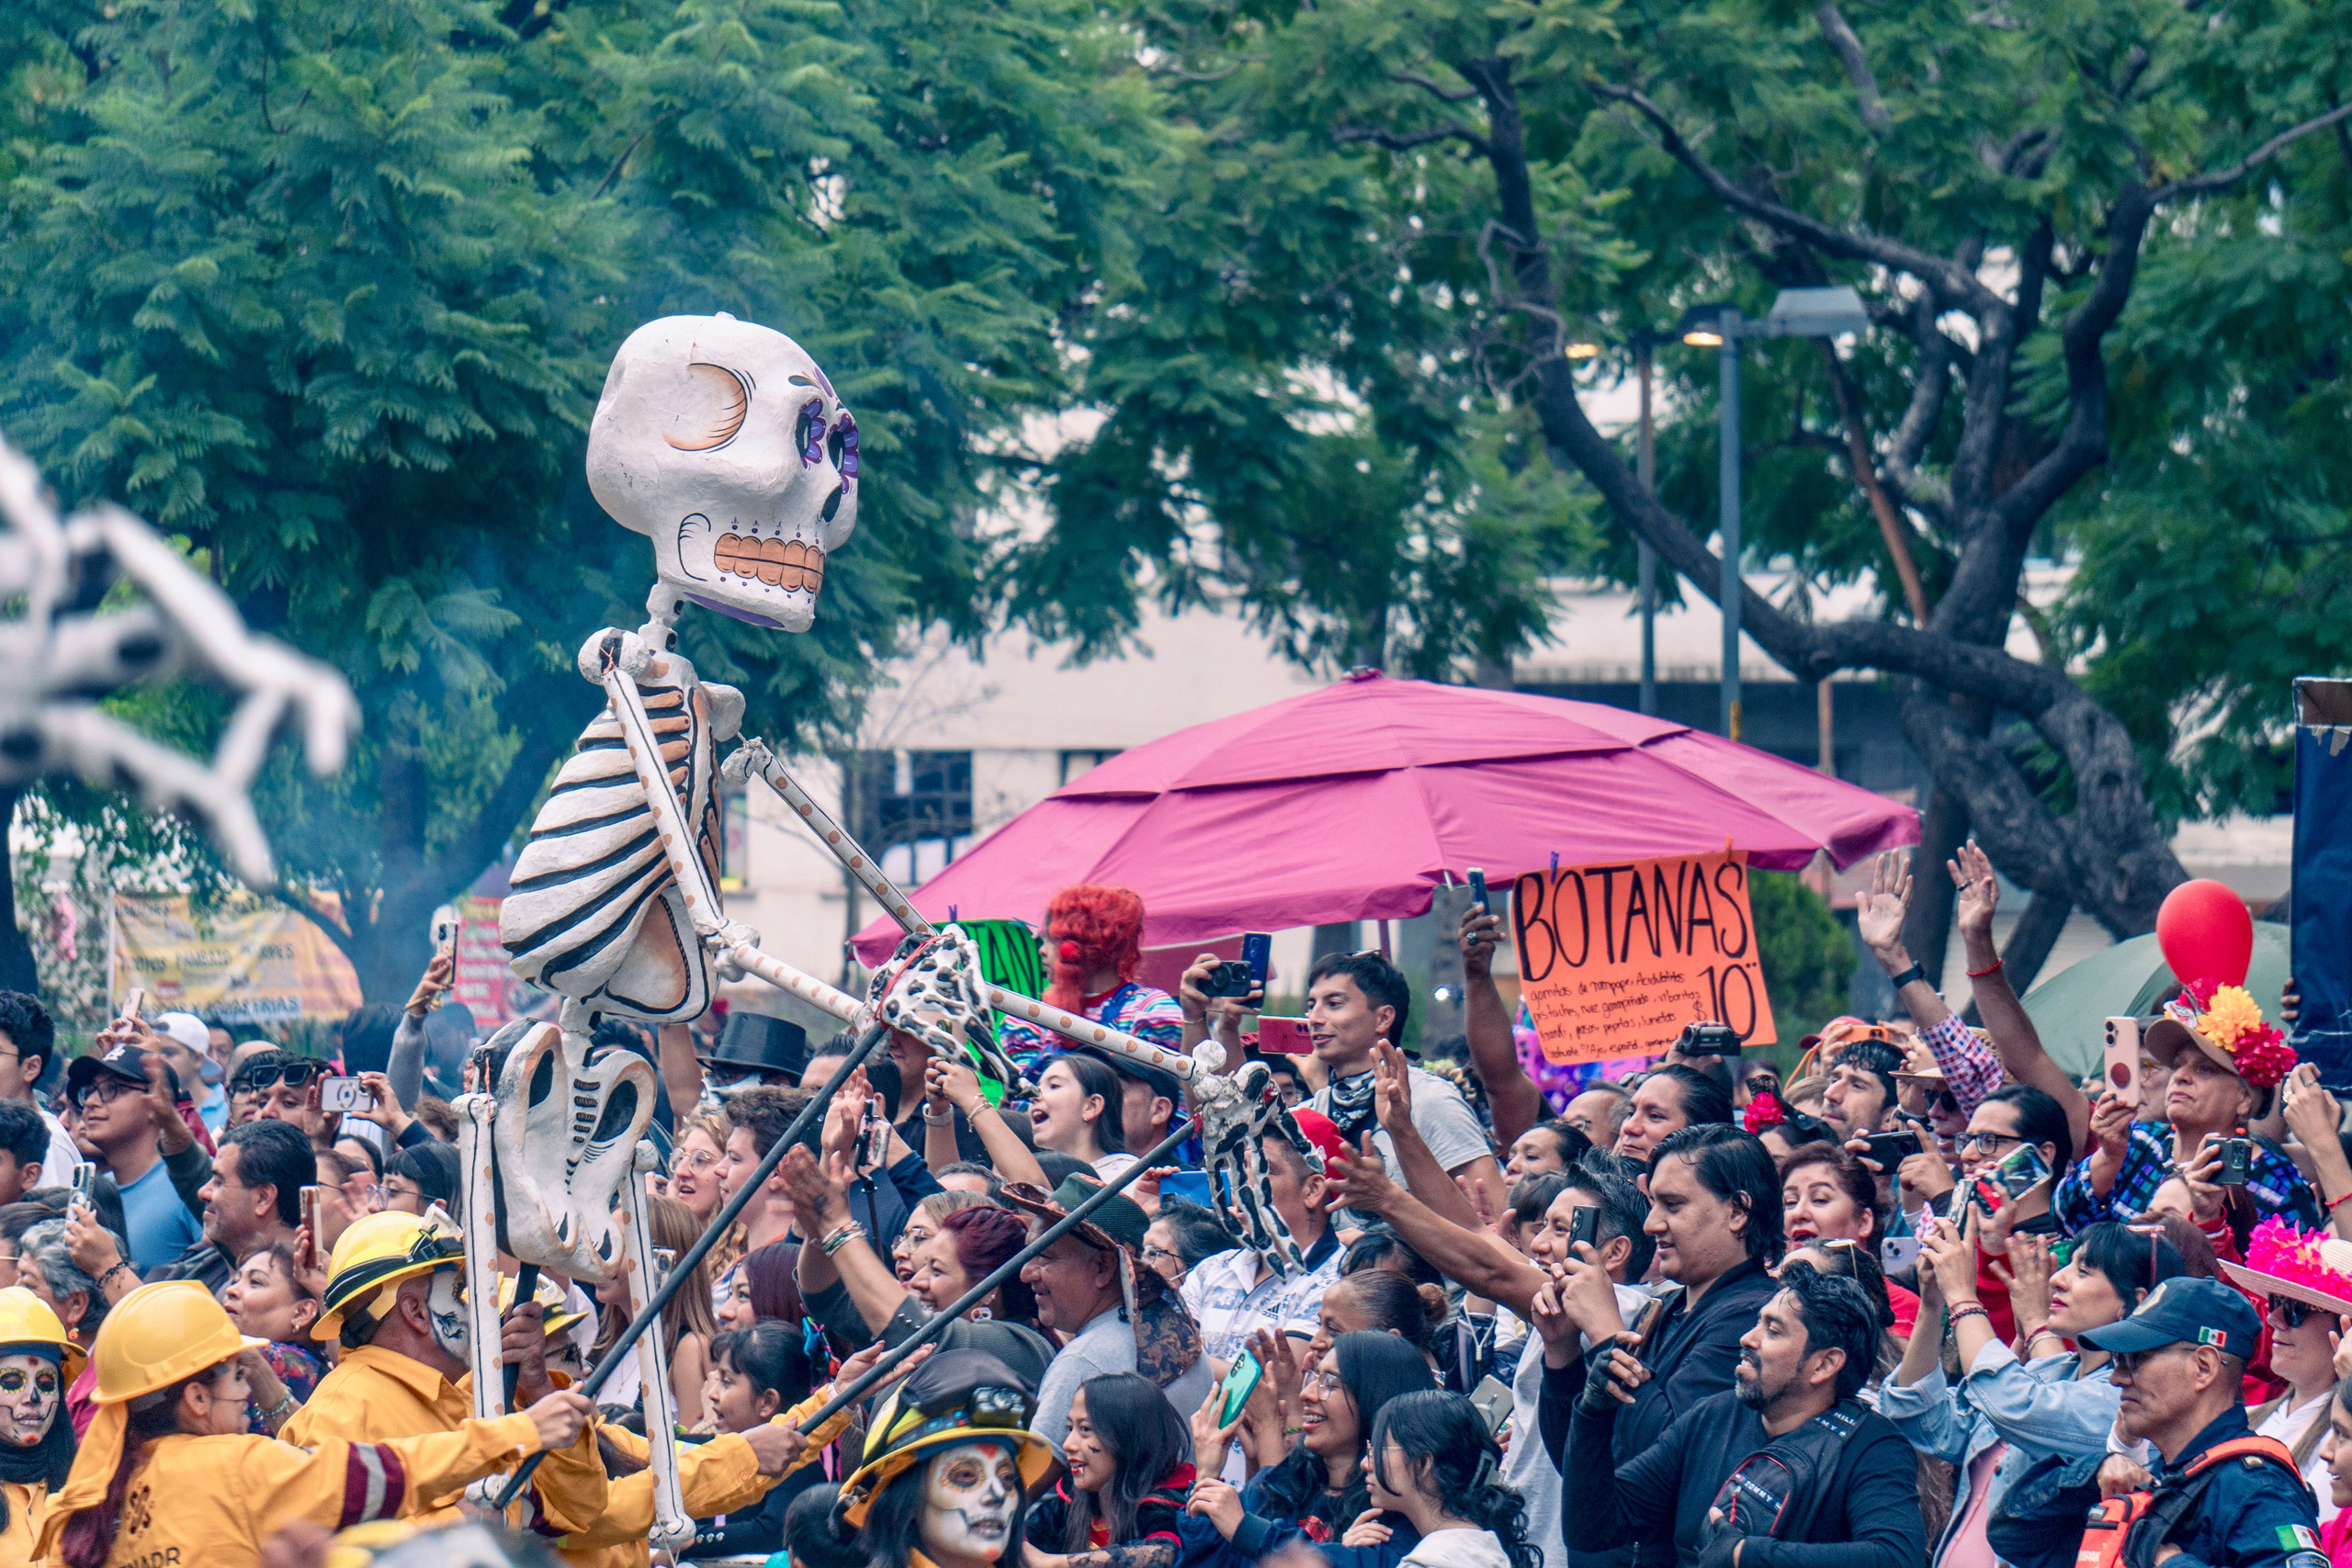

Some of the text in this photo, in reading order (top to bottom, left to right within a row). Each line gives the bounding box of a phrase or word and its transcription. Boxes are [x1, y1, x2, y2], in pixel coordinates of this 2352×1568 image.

[1514, 861, 1747, 982] BOTANAS
[1531, 983, 1572, 1010] gomitas
[1578, 981, 1588, 995] de
[1745, 1480, 1773, 1503] TOMMY
